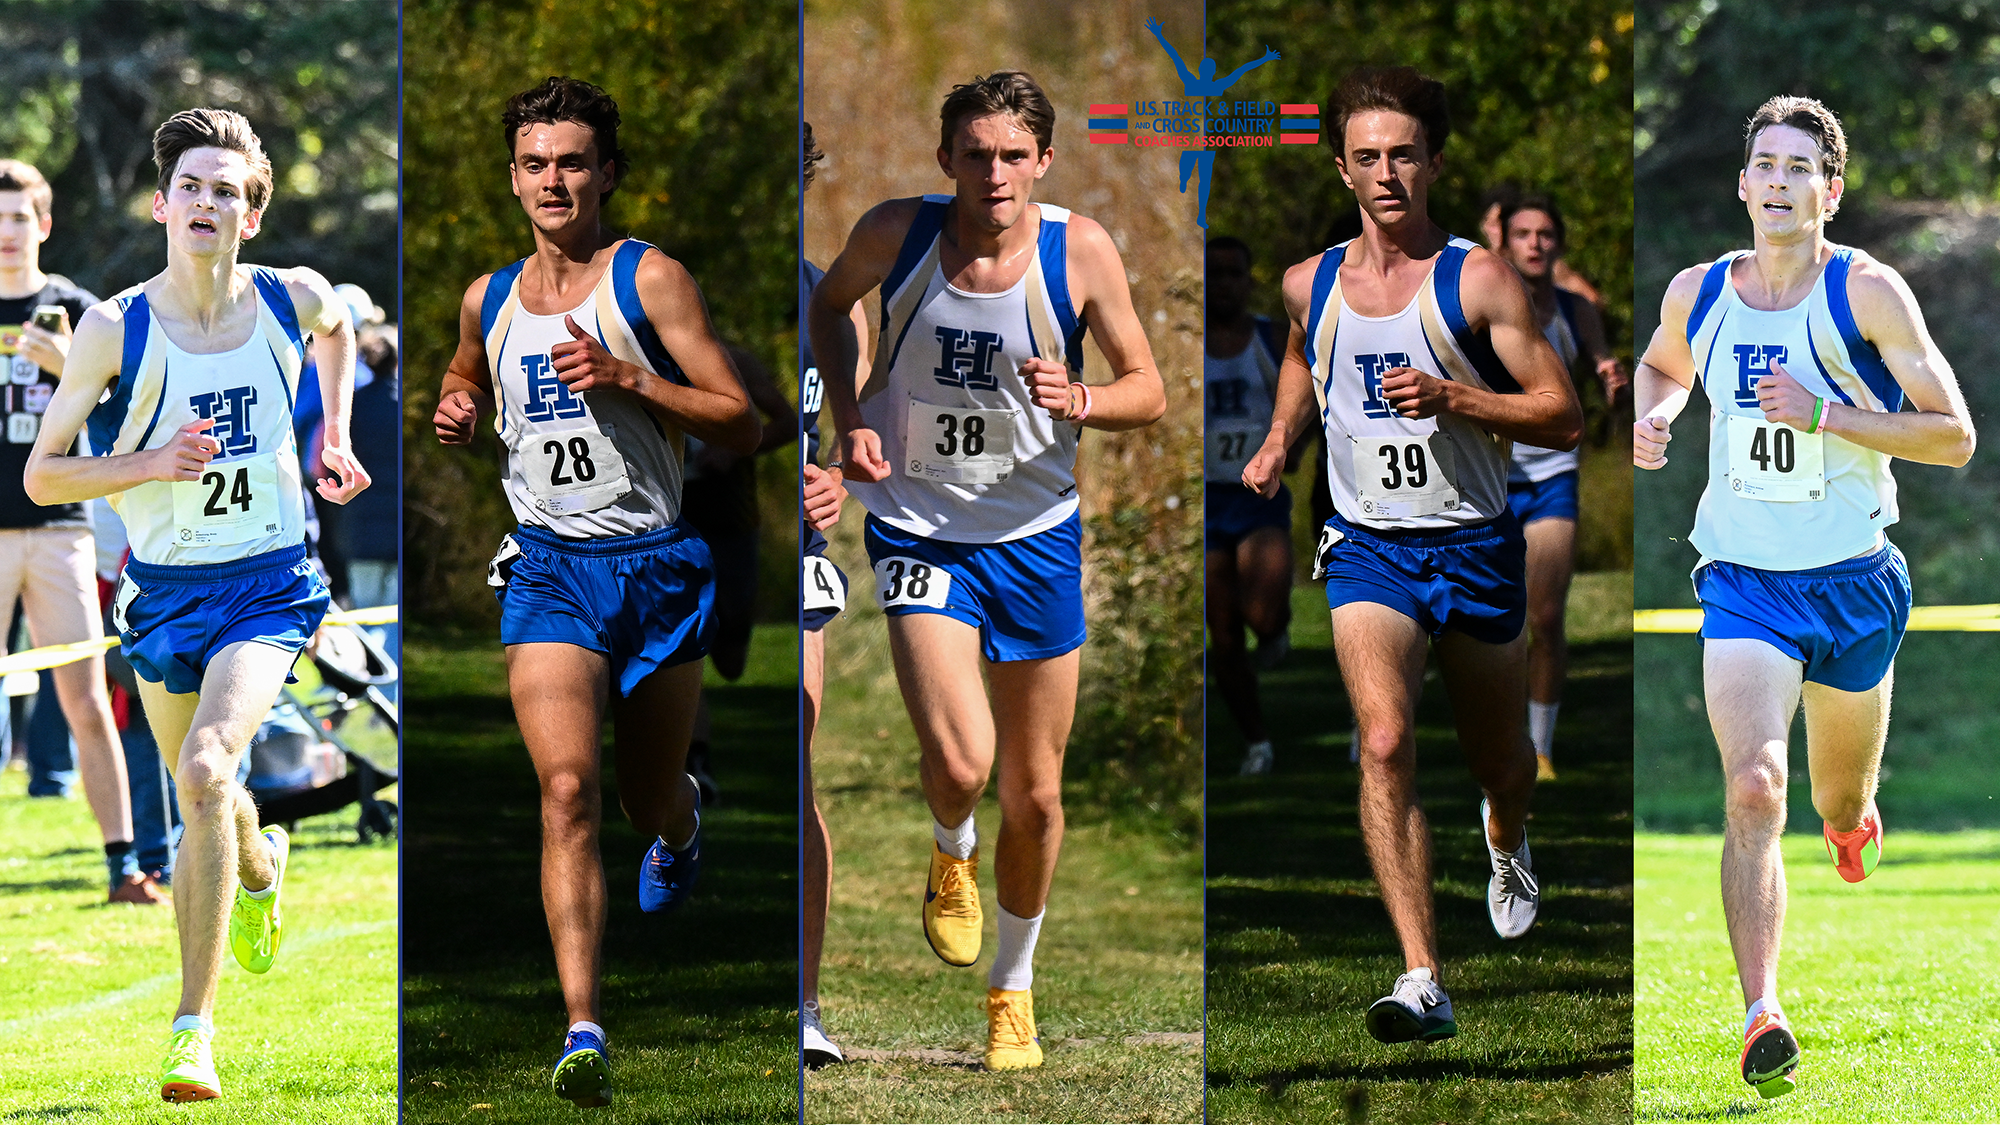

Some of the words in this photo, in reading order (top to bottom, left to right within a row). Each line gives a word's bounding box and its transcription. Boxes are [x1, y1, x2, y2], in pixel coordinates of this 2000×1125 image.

[933, 325, 1003, 392] H
[520, 352, 587, 423] H
[189, 385, 258, 460] H
[935, 413, 985, 457] 38
[1219, 431, 1247, 461] 27
[543, 436, 597, 487] 28
[1378, 443, 1428, 490] 39
[1750, 427, 1795, 473] 40
[202, 467, 253, 517] 24
[804, 561, 835, 602] 4
[883, 559, 932, 602] 38
